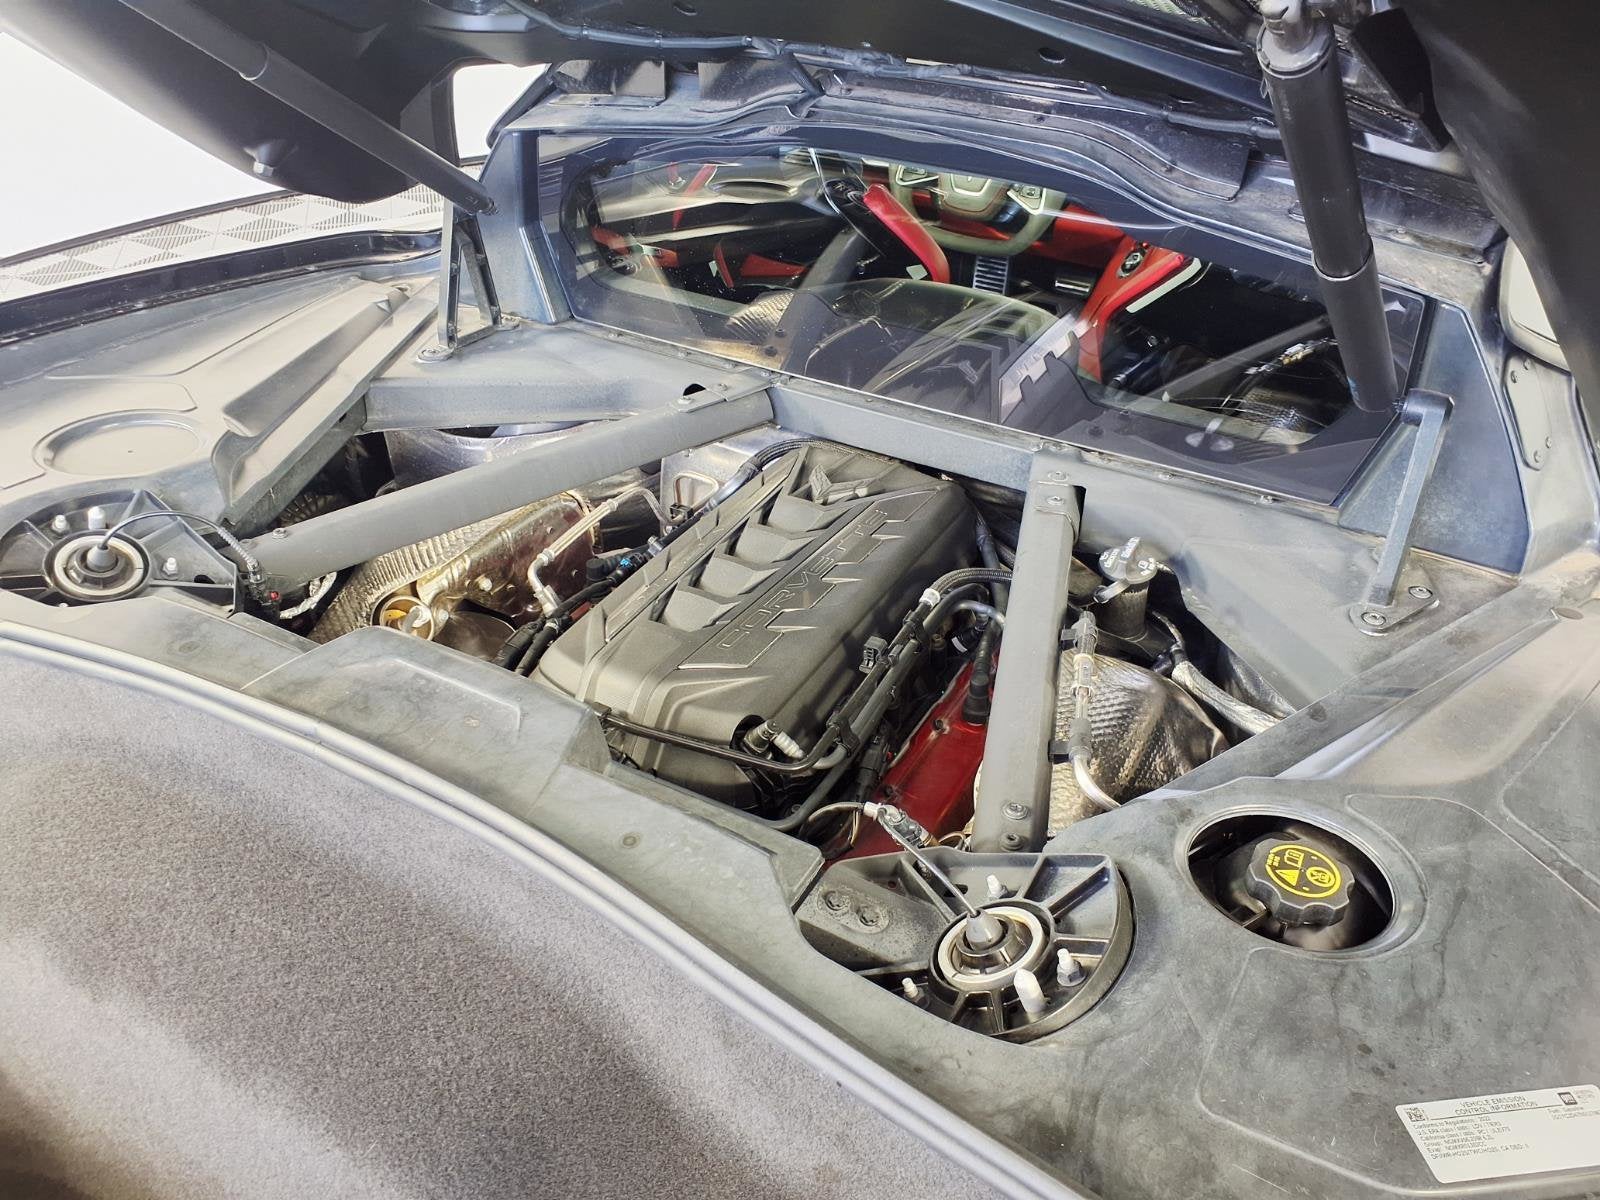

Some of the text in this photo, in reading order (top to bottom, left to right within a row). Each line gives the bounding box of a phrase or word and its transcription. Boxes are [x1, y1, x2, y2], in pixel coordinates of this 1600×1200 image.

[715, 508, 889, 650] CORVETTE
[1455, 1101, 1538, 1115] CONTROL INFORMATION
[1460, 1095, 1526, 1108] VEHICLE EMISSION
